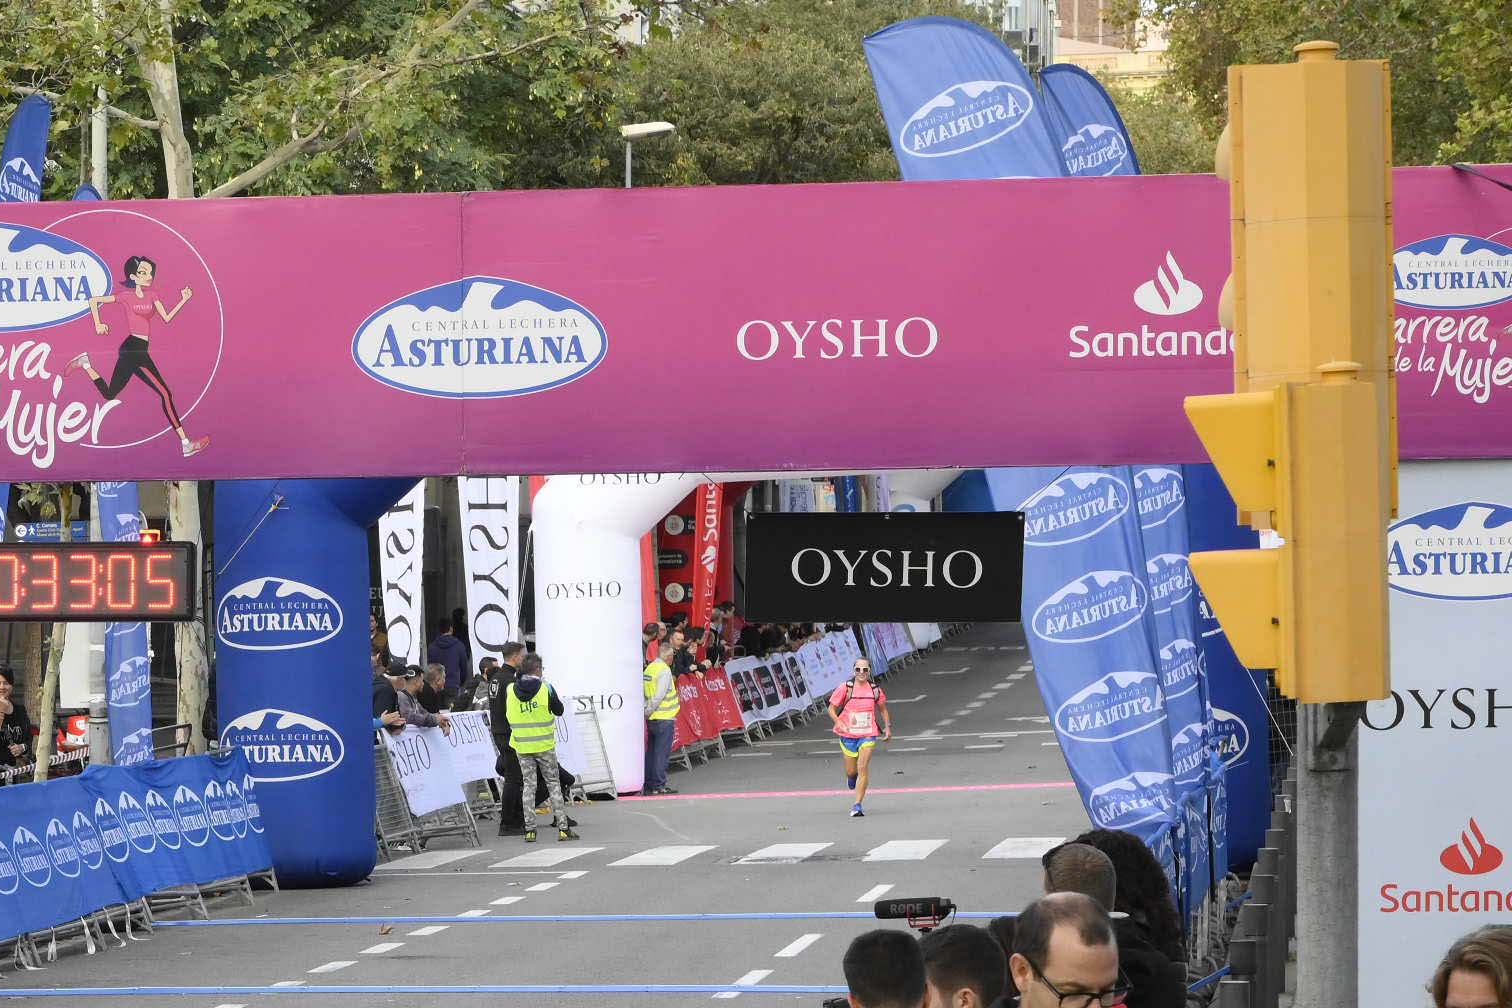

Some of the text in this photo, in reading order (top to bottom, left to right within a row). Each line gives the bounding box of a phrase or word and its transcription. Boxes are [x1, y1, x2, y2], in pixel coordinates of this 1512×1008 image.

[16, 258, 87, 271] LECHERA
[1465, 259, 1512, 268] LECHER
[412, 317, 578, 332] CENTRAL LECHERA
[1394, 315, 1489, 344] arrera
[373, 323, 587, 367] ASTURIANA
[737, 317, 938, 360] OYSHO
[1069, 325, 1235, 358] Santand
[1417, 345, 1435, 372] la
[1431, 339, 1512, 404] Muje
[1415, 537, 1482, 546] CENTRAL
[791, 548, 983, 588] OYSHO
[546, 581, 622, 600] OYSHO
[234, 602, 329, 610] CENTRAL LECHERA
[221, 606, 333, 635] ASTURIANA
[520, 699, 538, 713] Life
[576, 693, 623, 712] SHO
[235, 734, 329, 742] CENTRAL LECHERA
